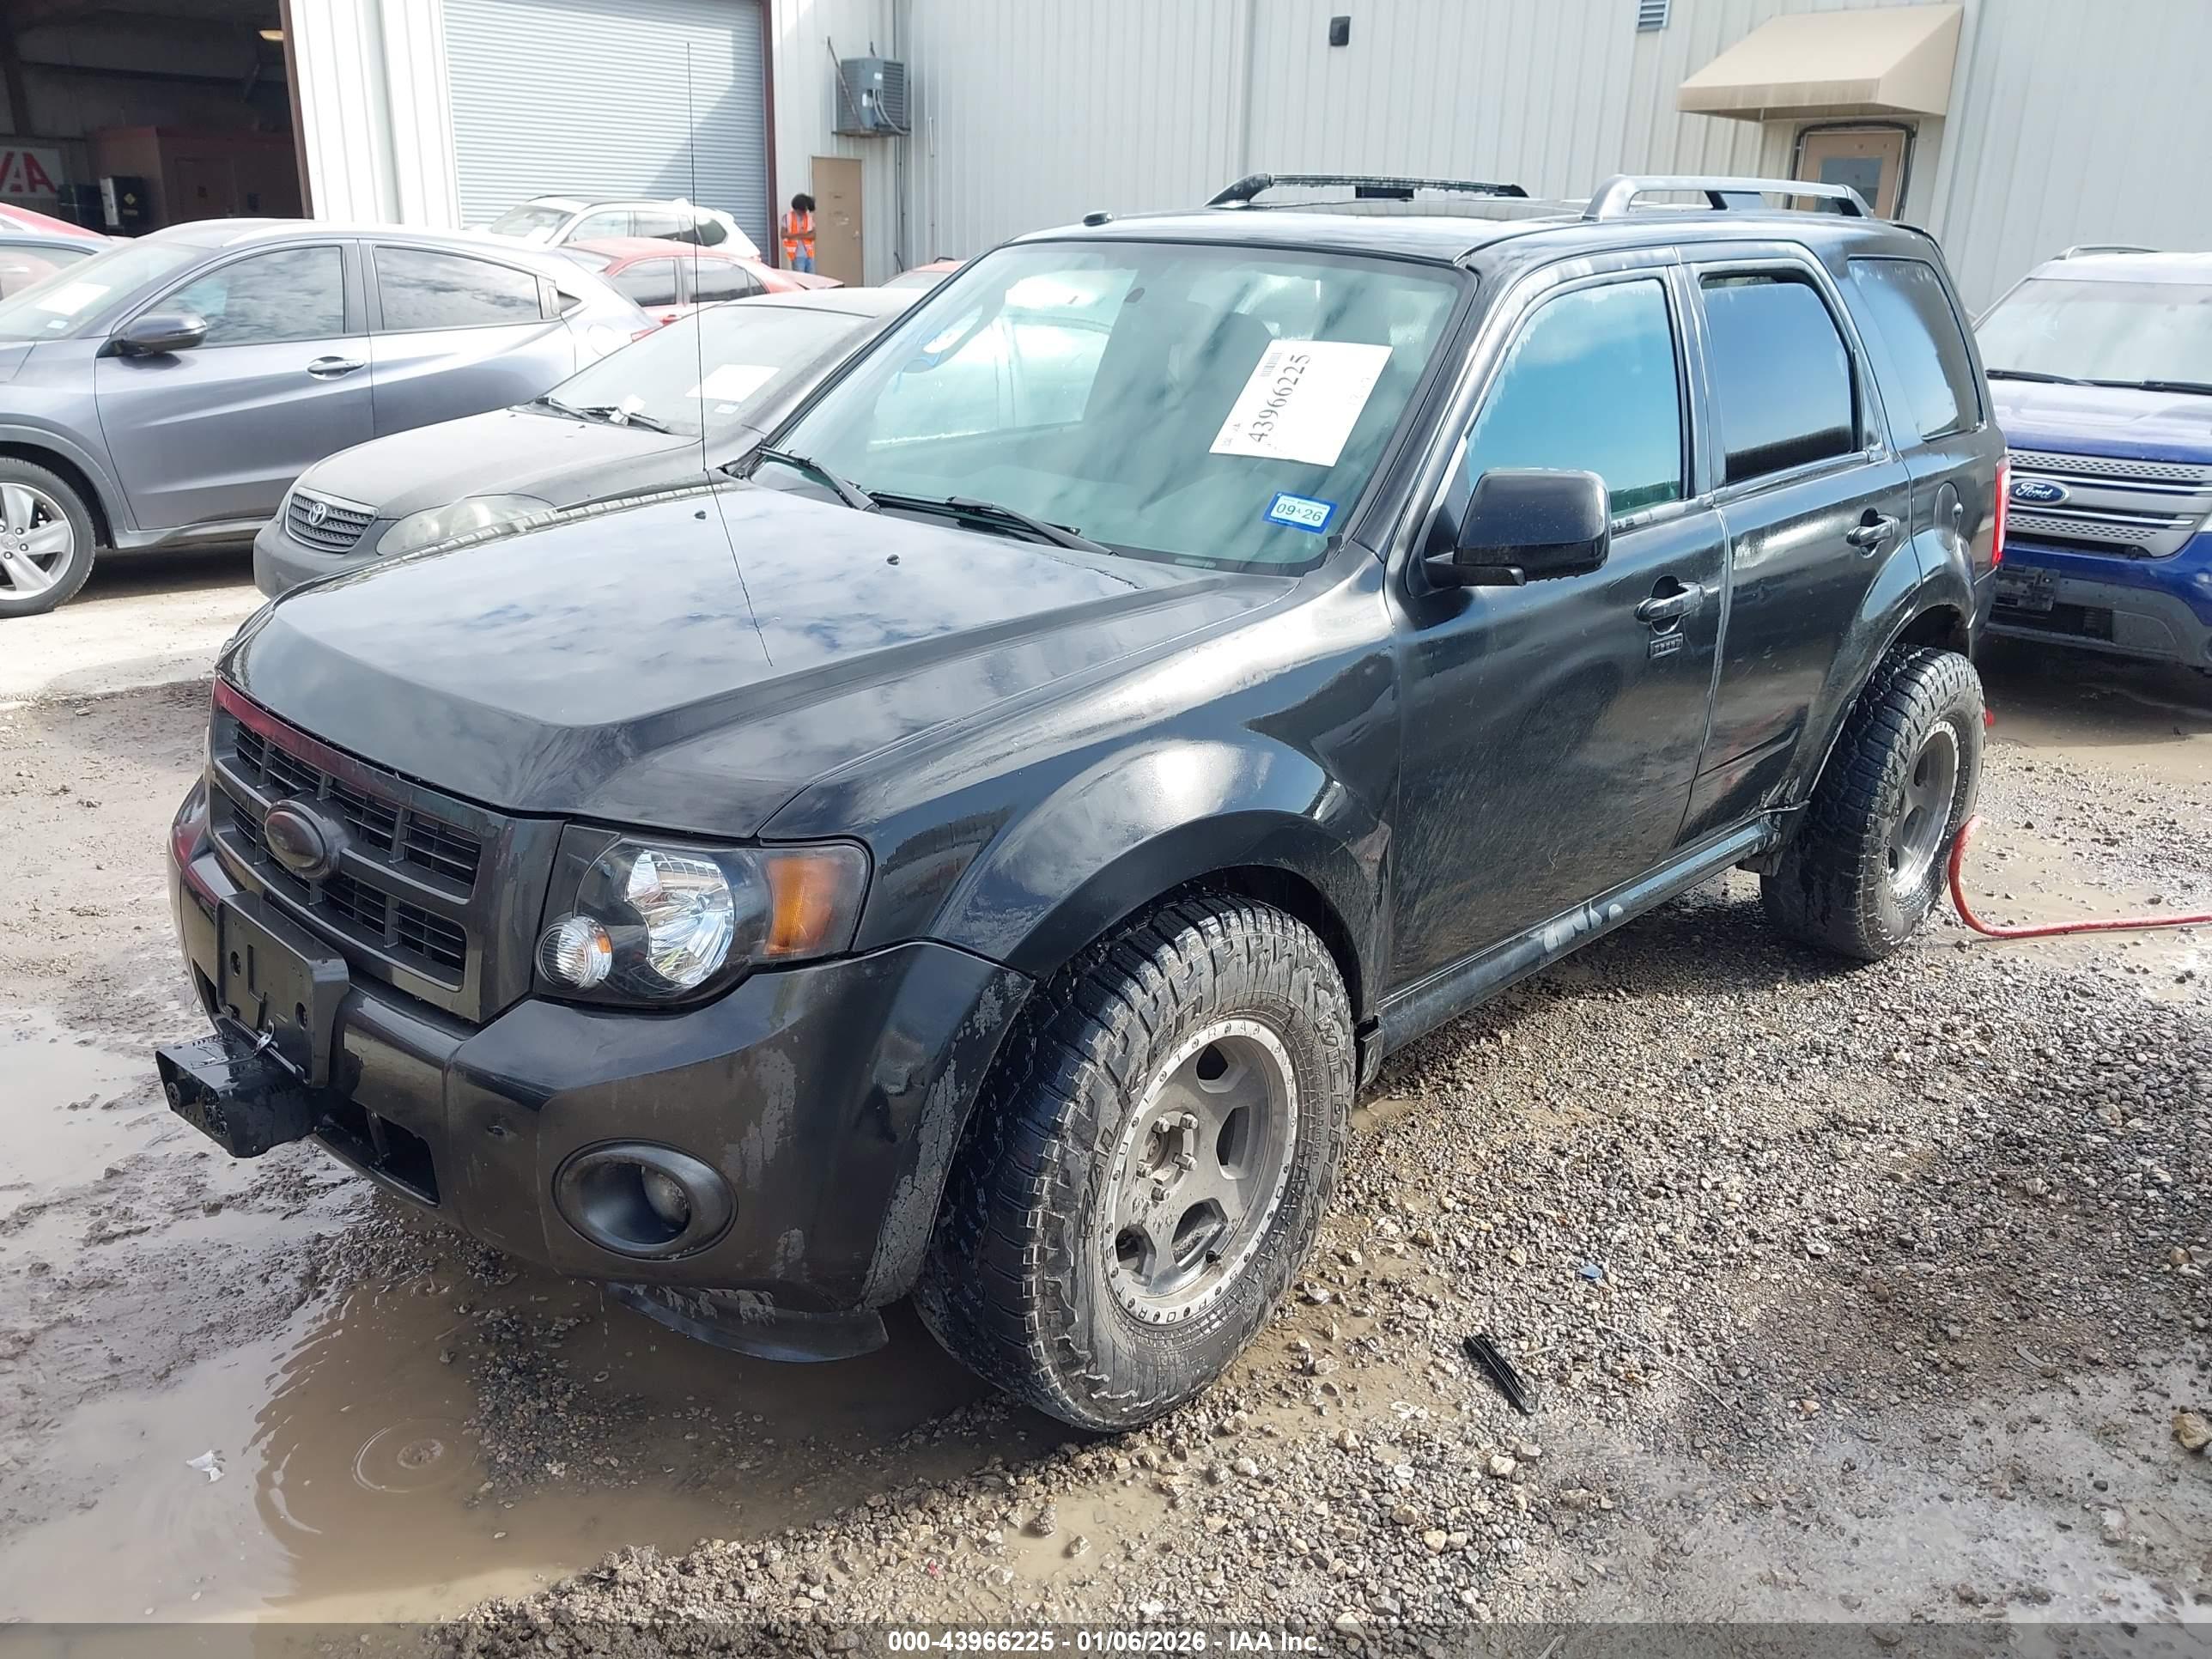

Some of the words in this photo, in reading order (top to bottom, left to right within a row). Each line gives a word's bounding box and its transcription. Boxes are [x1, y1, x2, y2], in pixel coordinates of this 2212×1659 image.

[1248, 355, 1310, 443] 43966225
[2015, 483, 2053, 498] Ford
[1276, 503, 1296, 515] 09
[1301, 508, 1323, 521] 26
